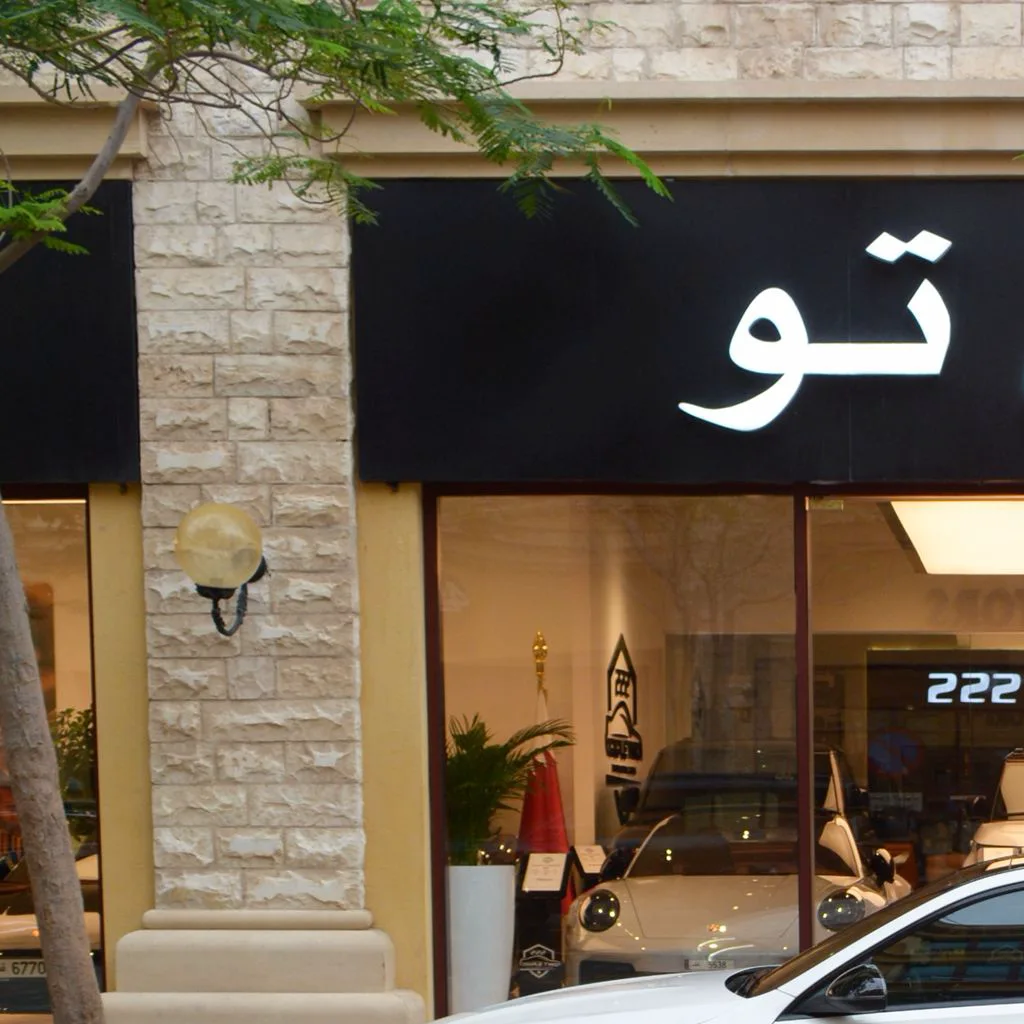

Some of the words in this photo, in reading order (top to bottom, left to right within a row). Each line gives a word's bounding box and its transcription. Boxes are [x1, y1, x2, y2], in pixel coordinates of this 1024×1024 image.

[678, 229, 953, 432] تو
[927, 673, 1021, 703] 222
[11, 961, 46, 975] 6770
